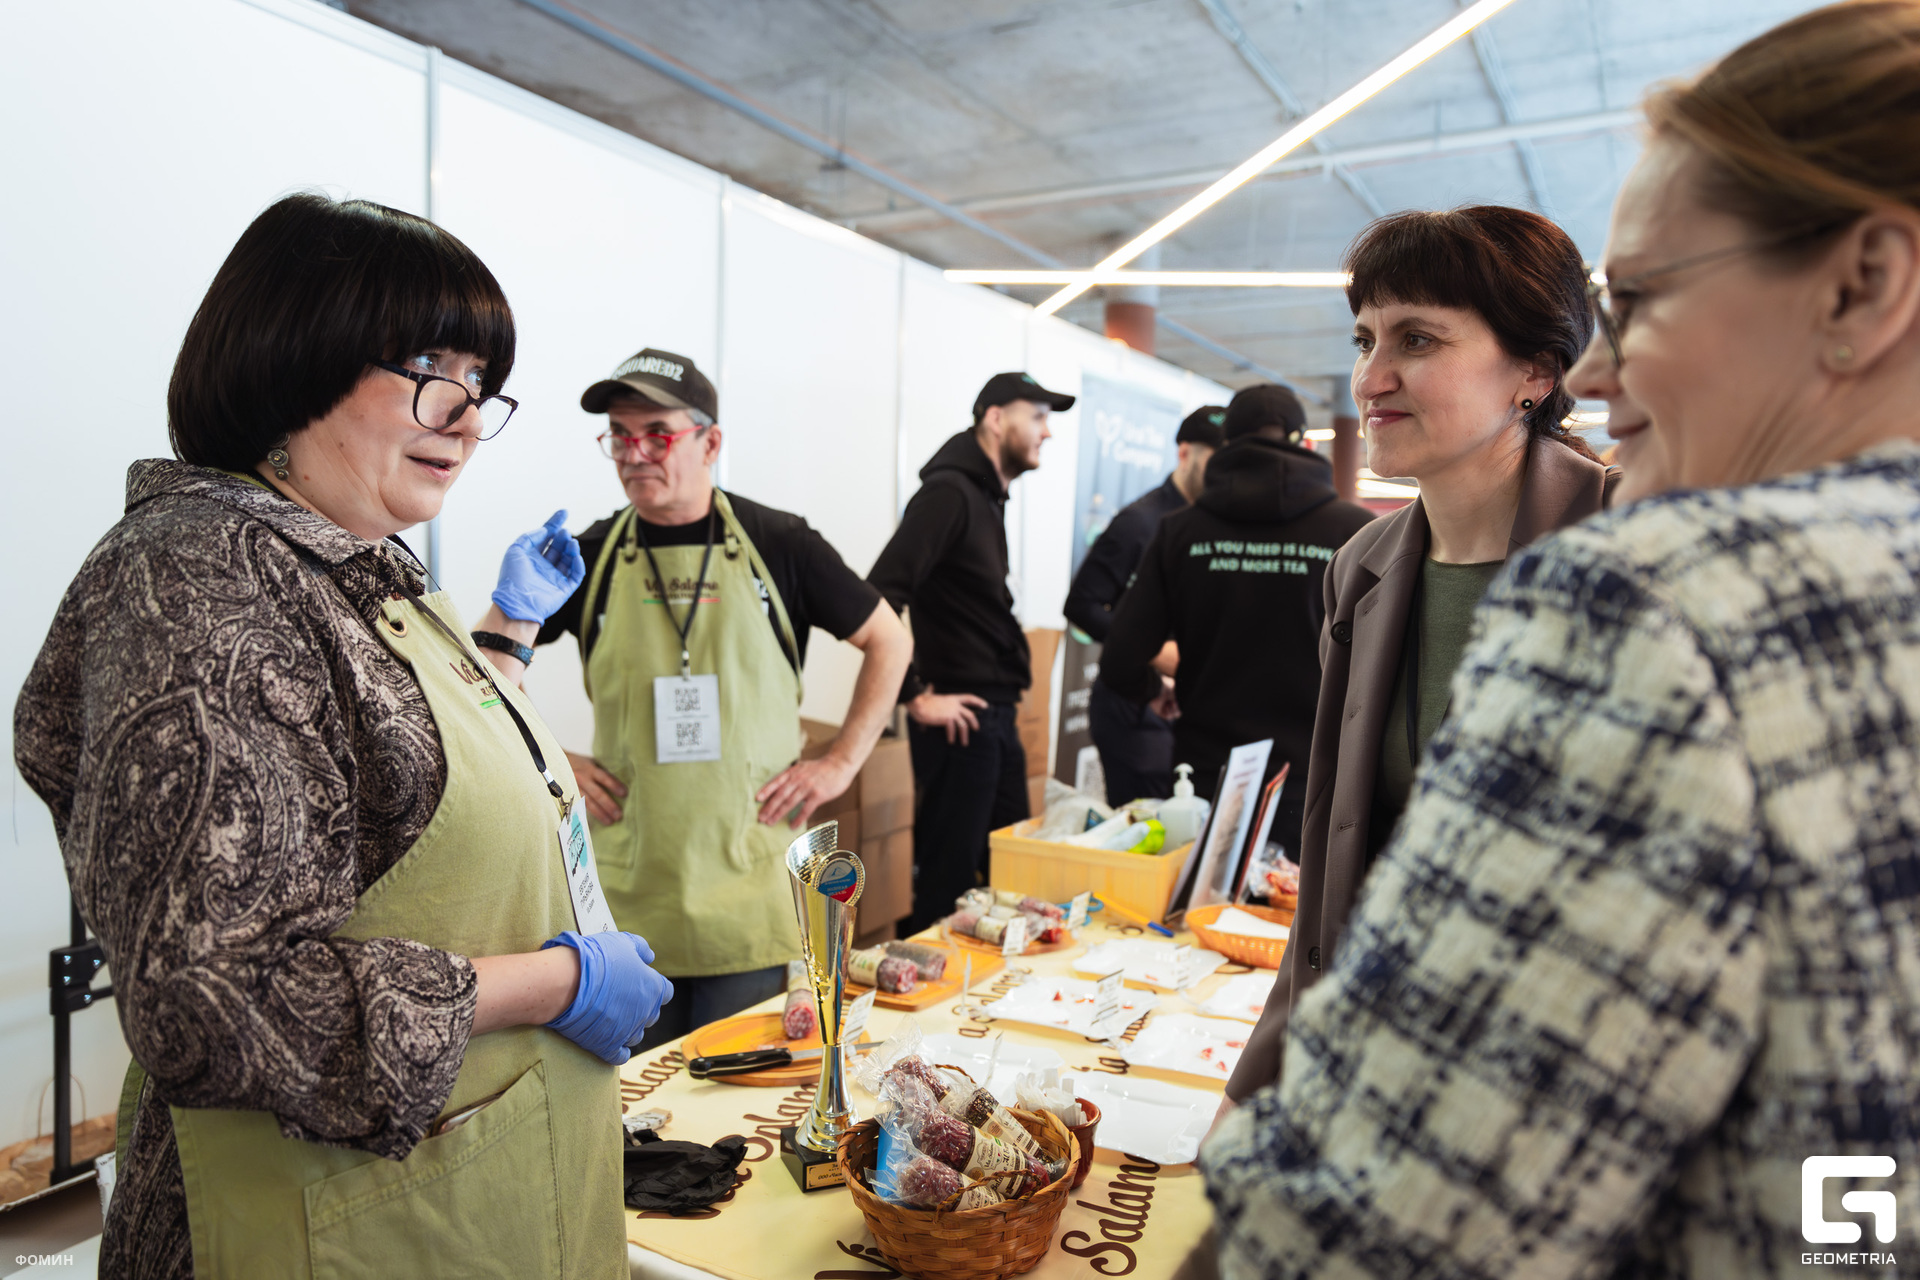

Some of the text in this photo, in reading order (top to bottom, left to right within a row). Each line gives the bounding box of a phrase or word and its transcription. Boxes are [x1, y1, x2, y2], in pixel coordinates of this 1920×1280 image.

[1189, 542, 1212, 557] ALL
[1214, 540, 1244, 555] YOU
[1245, 542, 1281, 556] NEED
[1282, 542, 1297, 556] IS
[1208, 557, 1309, 575] AND MORE TEA
[1061, 1153, 1160, 1276] Salam
